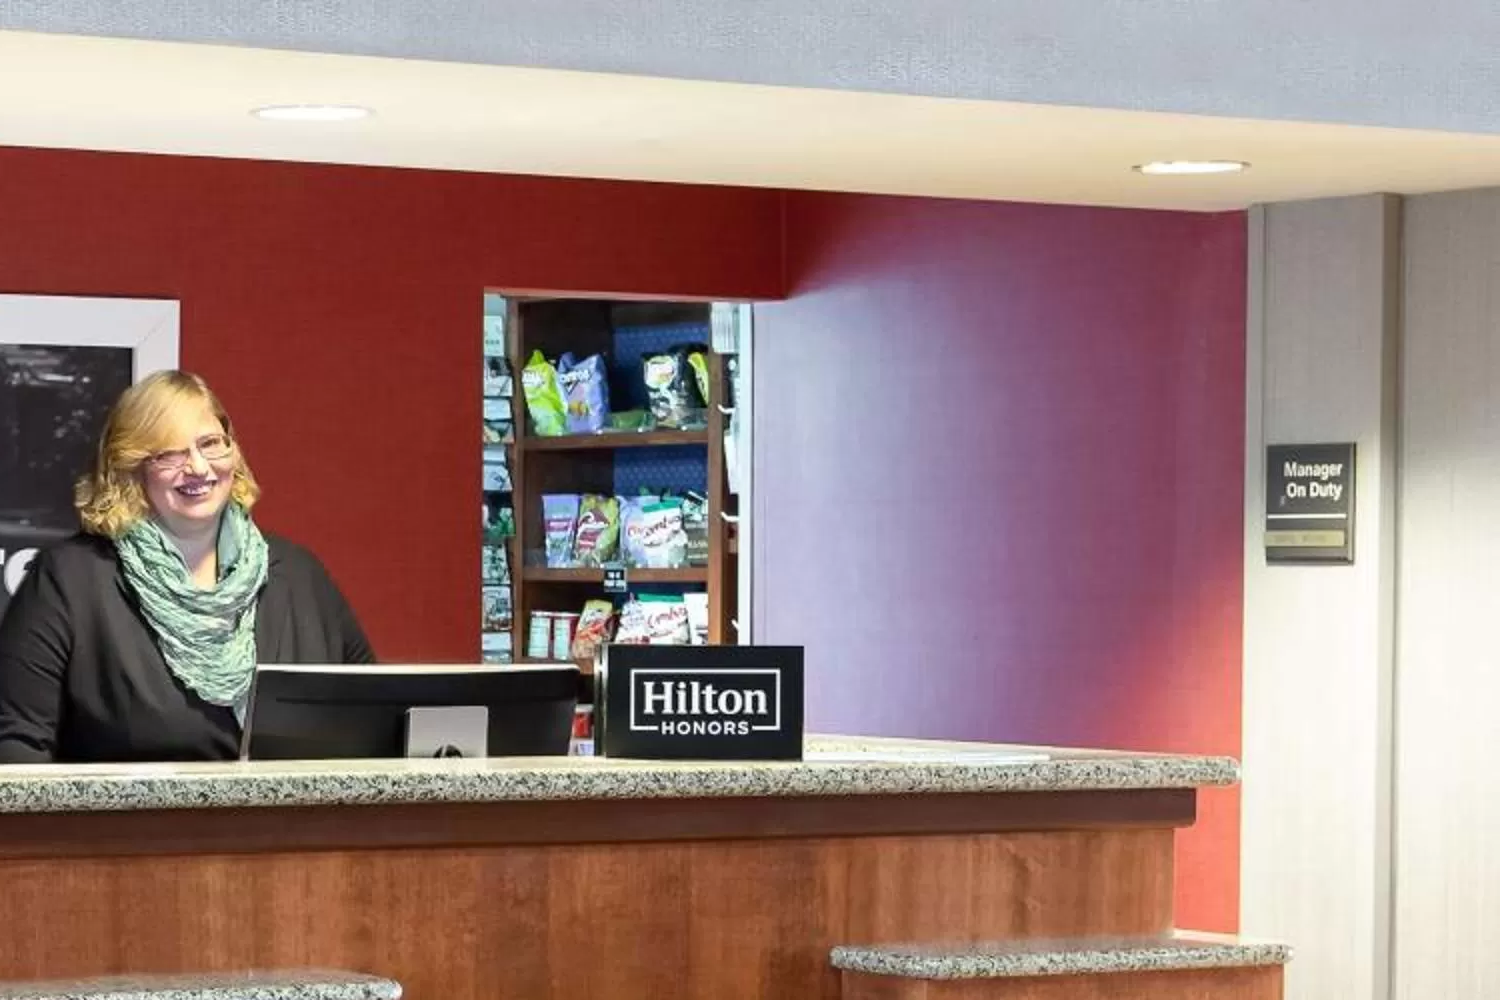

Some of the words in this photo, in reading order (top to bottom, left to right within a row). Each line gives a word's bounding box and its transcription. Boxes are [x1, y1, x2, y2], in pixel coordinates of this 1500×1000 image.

[1283, 460, 1343, 481] Manager
[1286, 482, 1307, 498] On
[1309, 481, 1343, 502] Duty
[643, 681, 768, 715] Hilton
[661, 720, 749, 735] HONORS
